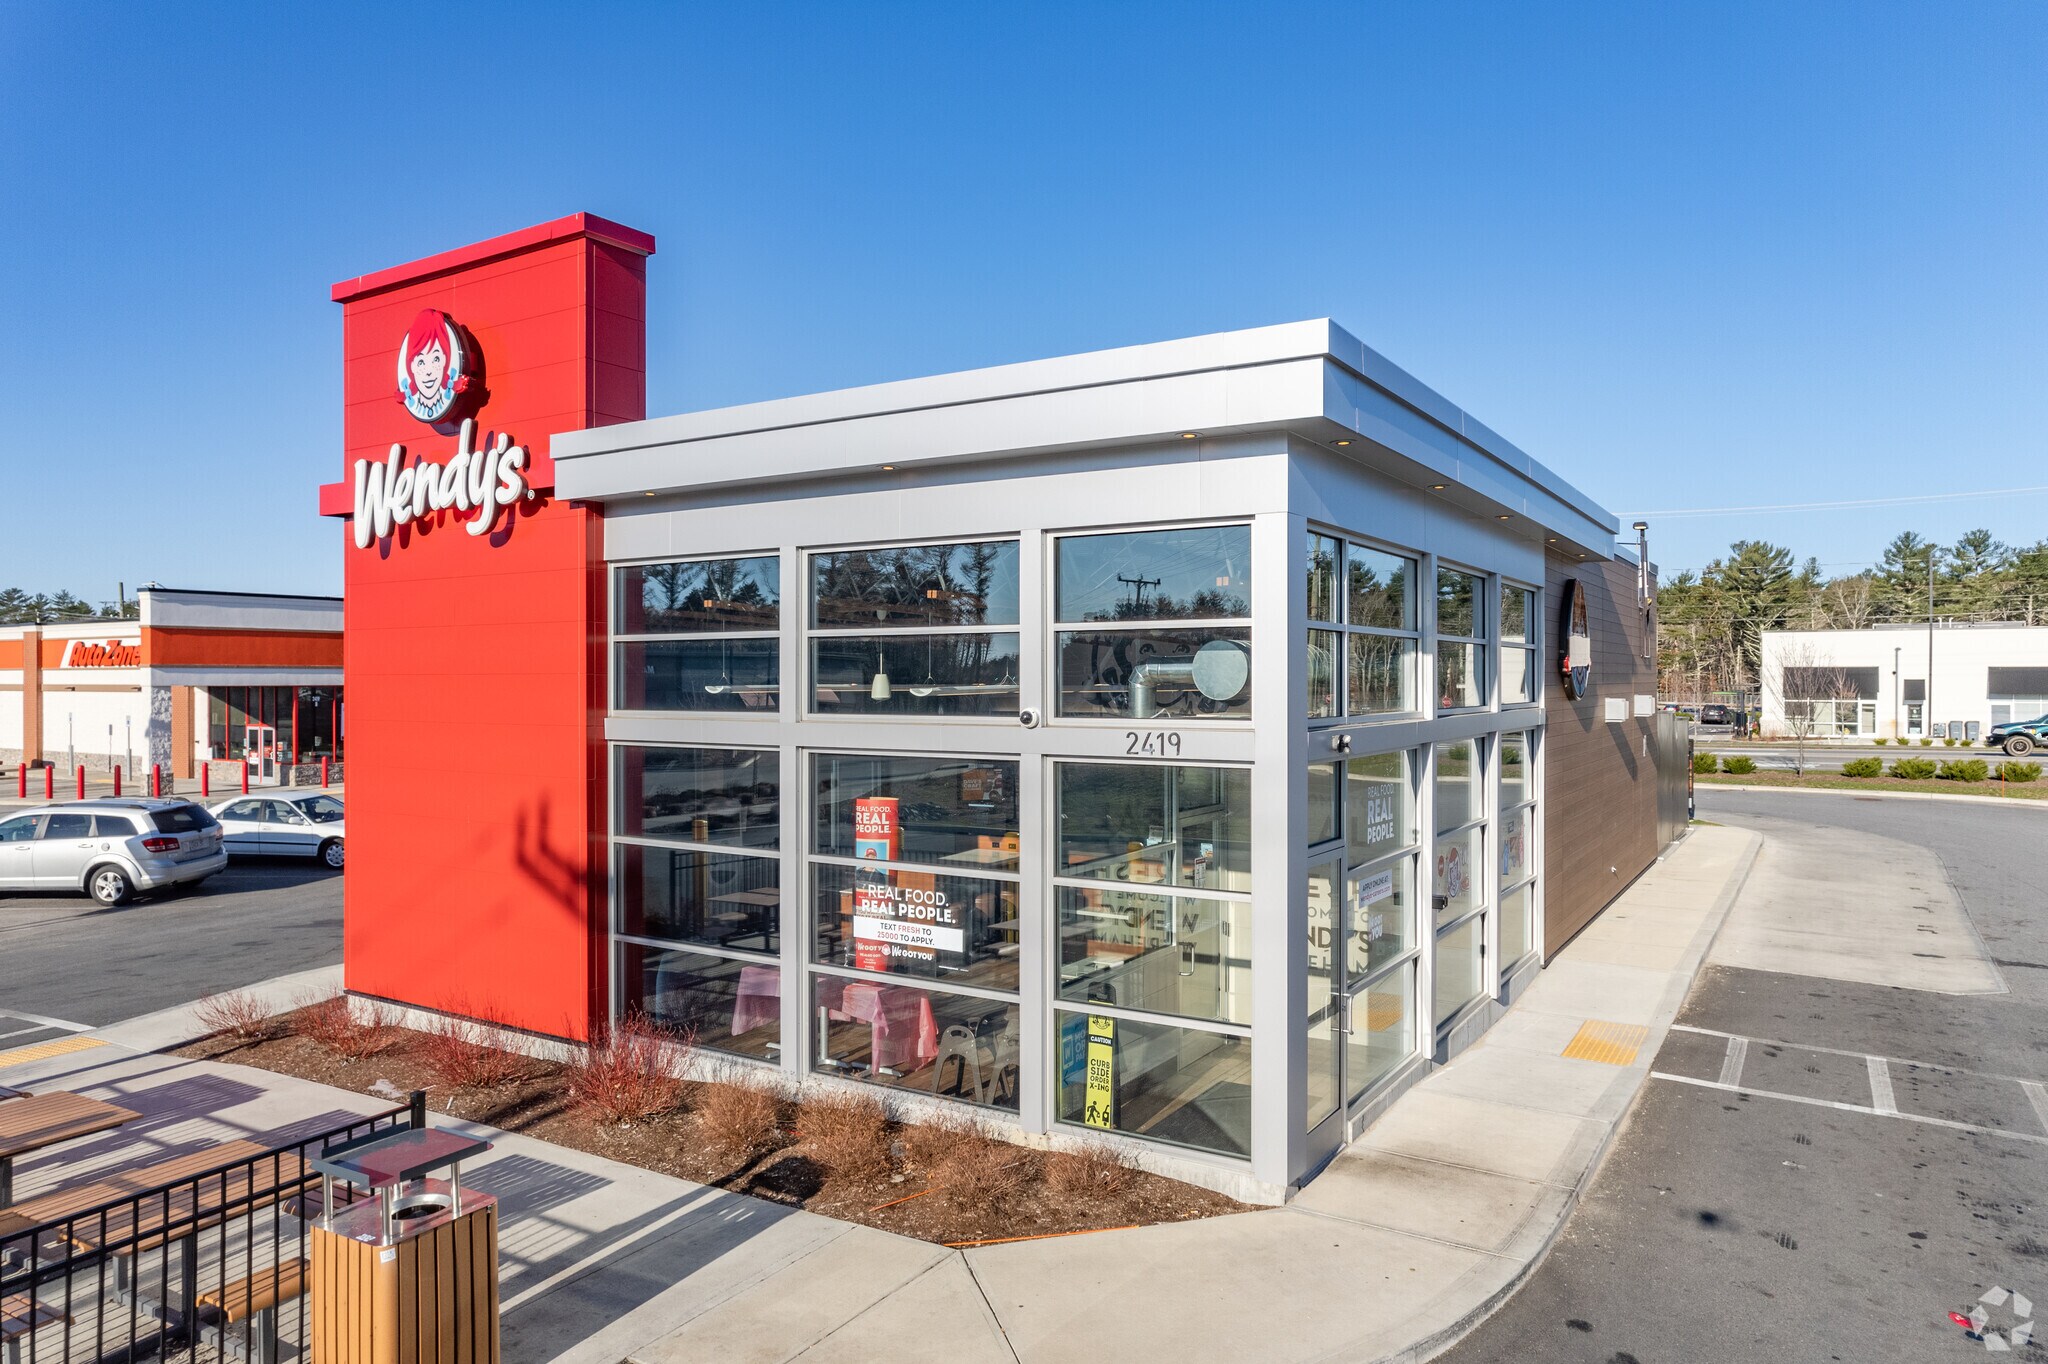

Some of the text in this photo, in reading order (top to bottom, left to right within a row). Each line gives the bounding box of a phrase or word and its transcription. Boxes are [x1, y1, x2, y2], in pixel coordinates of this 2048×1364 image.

[354, 418, 524, 549] Wendy's
[68, 640, 140, 667] AutoZone
[1126, 731, 1181, 756] 2419
[1367, 797, 1393, 825] REAL
[856, 812, 890, 825] REAL
[856, 824, 891, 834] PEOPLE.
[1367, 821, 1395, 845] PEOPLE.
[868, 884, 949, 907] REAL FOOD.
[861, 899, 956, 924] REAL PEOPLE.
[880, 922, 932, 936] TEXT FRESH TO
[877, 931, 935, 946] 25000 TO APPLY.
[902, 949, 918, 959] GOT
[917, 951, 933, 961] YOU
[1090, 1036, 1112, 1045] CAUTION
[1090, 1058, 1110, 1069] CURB
[1089, 1075, 1110, 1085] ORDER
[1090, 1067, 1110, 1079] SIDE
[1089, 1082, 1110, 1093] X-ING
